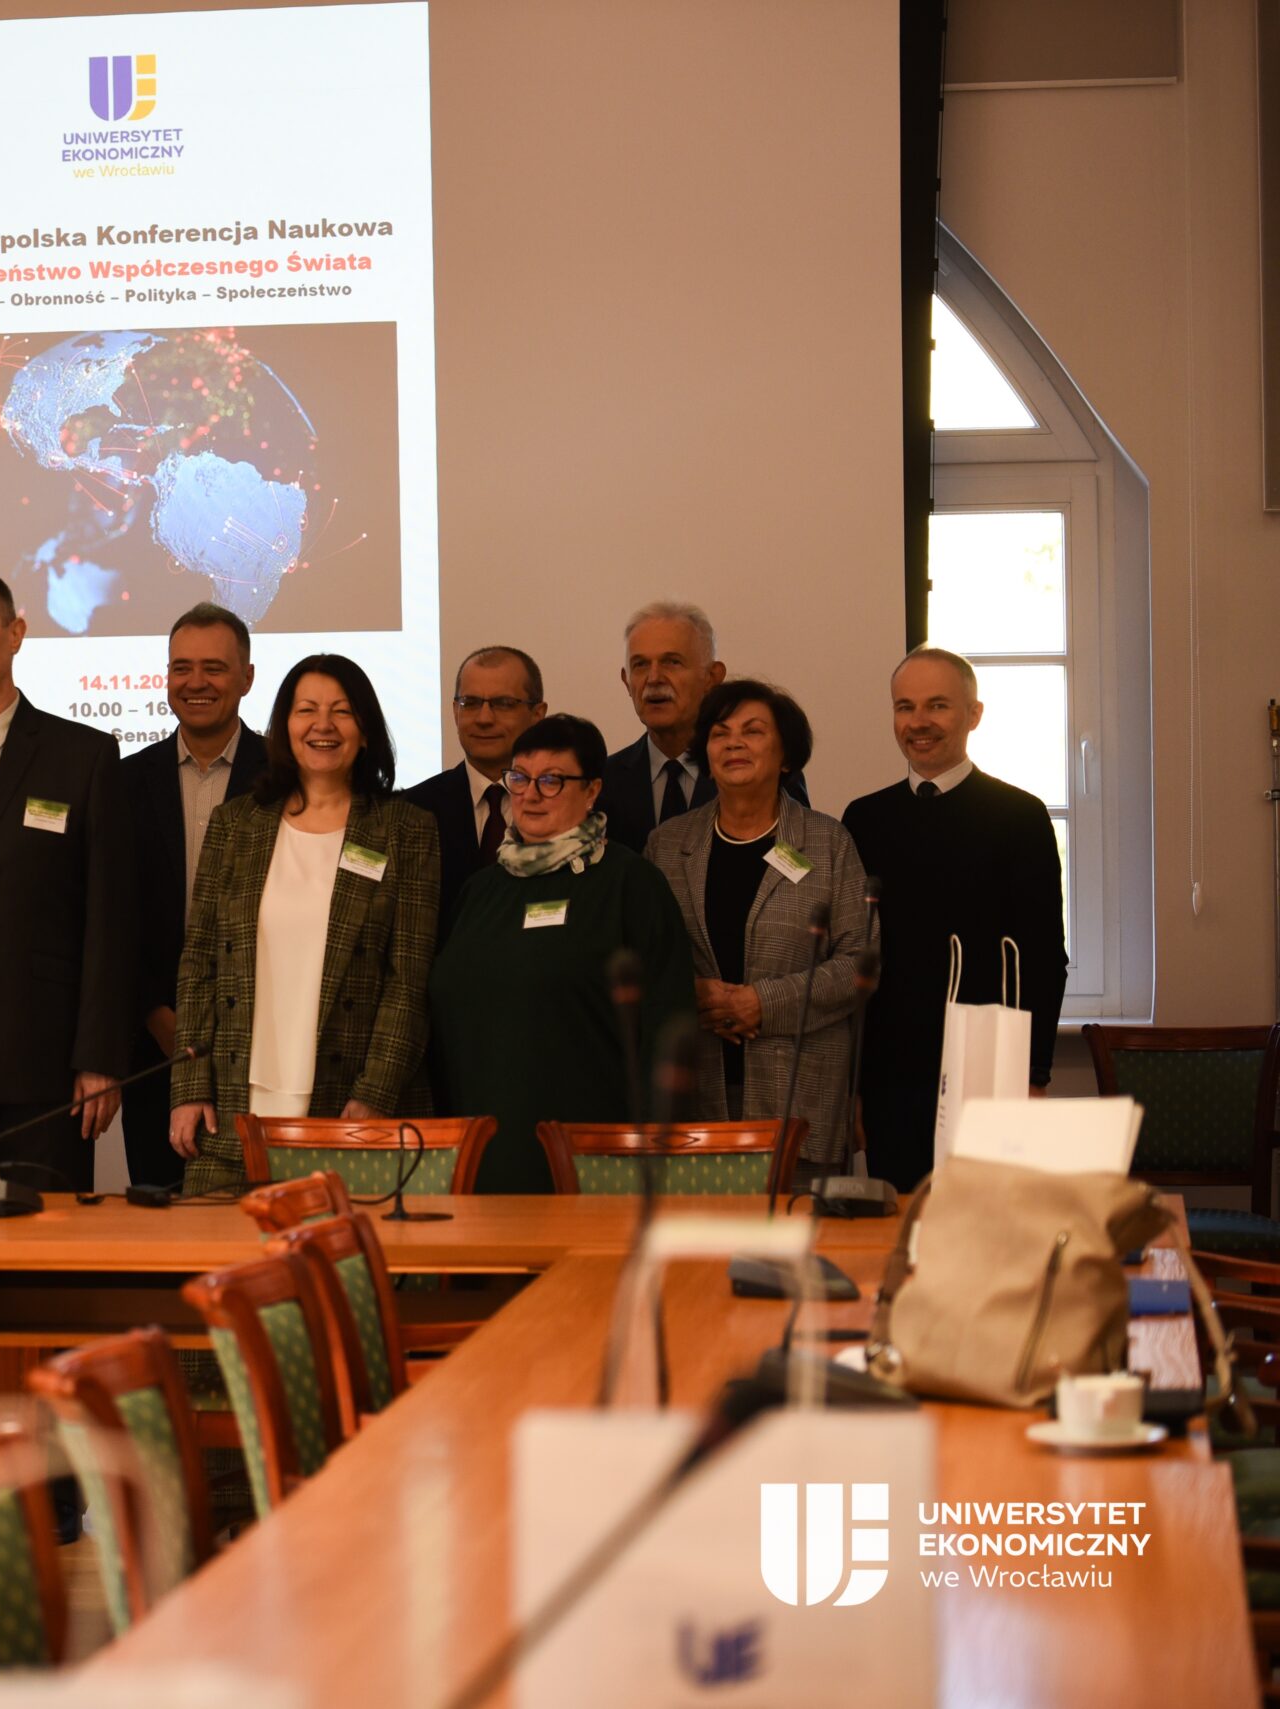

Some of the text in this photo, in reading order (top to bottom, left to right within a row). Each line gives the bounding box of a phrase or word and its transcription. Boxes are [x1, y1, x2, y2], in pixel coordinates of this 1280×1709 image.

[62, 128, 183, 145] UNIWERSYTET
[62, 145, 184, 162] EKONOMICZNY
[73, 164, 175, 178] we Wrocławiu
[97, 222, 258, 246] Konferencja
[268, 218, 393, 239] Naukowa
[89, 259, 278, 281] Współczesnego
[287, 251, 372, 272] Świata
[11, 291, 105, 306] Obronność
[125, 288, 196, 304] Polityka
[217, 284, 352, 302] Społeczeństwo
[79, 674, 169, 690] 14.11.20
[69, 702, 122, 717] 10.00
[111, 728, 174, 743] Senat
